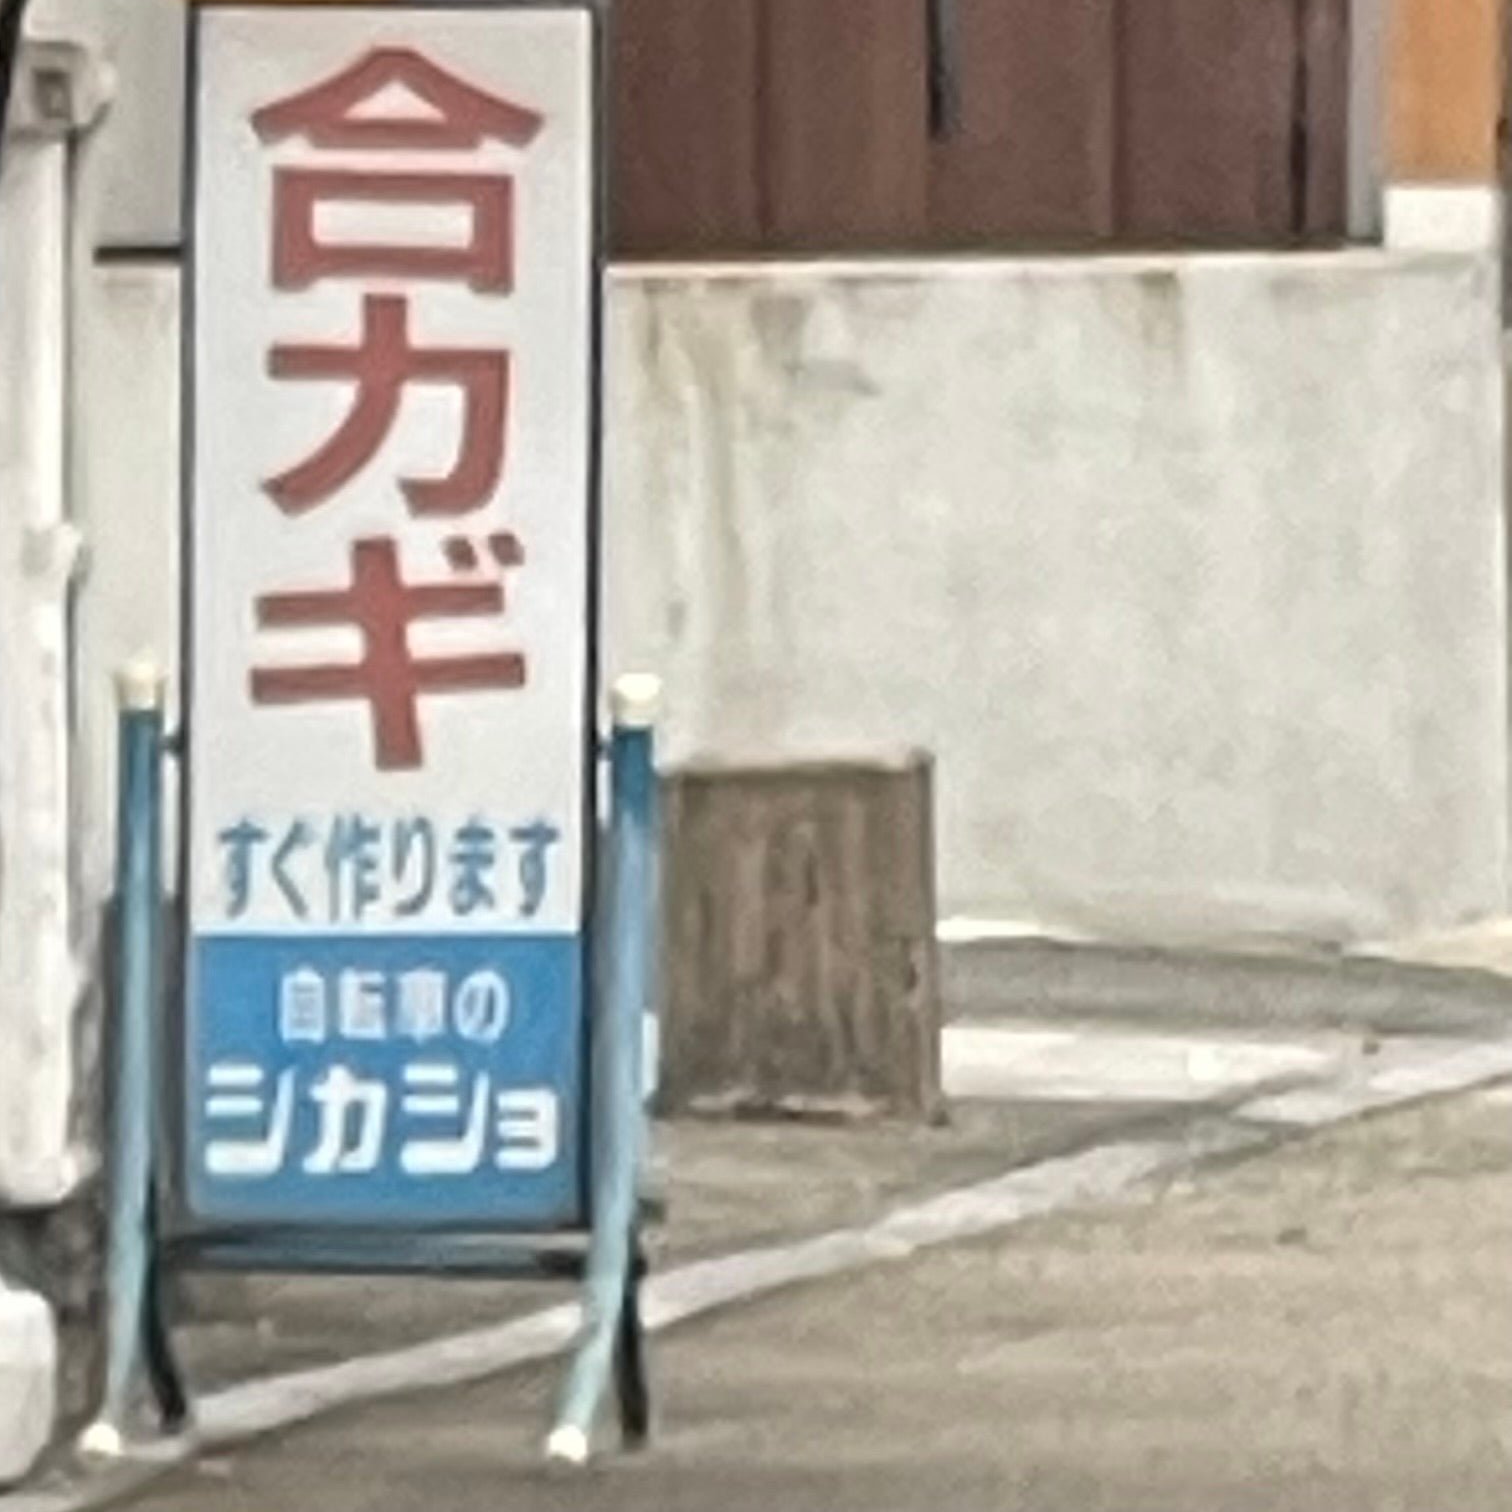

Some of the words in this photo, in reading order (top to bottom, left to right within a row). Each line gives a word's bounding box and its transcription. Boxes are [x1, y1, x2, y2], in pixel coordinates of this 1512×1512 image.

[249, 45, 544, 771] 合カギ
[218, 812, 560, 921] すぐ作ります
[204, 1062, 558, 1175] シカショ
